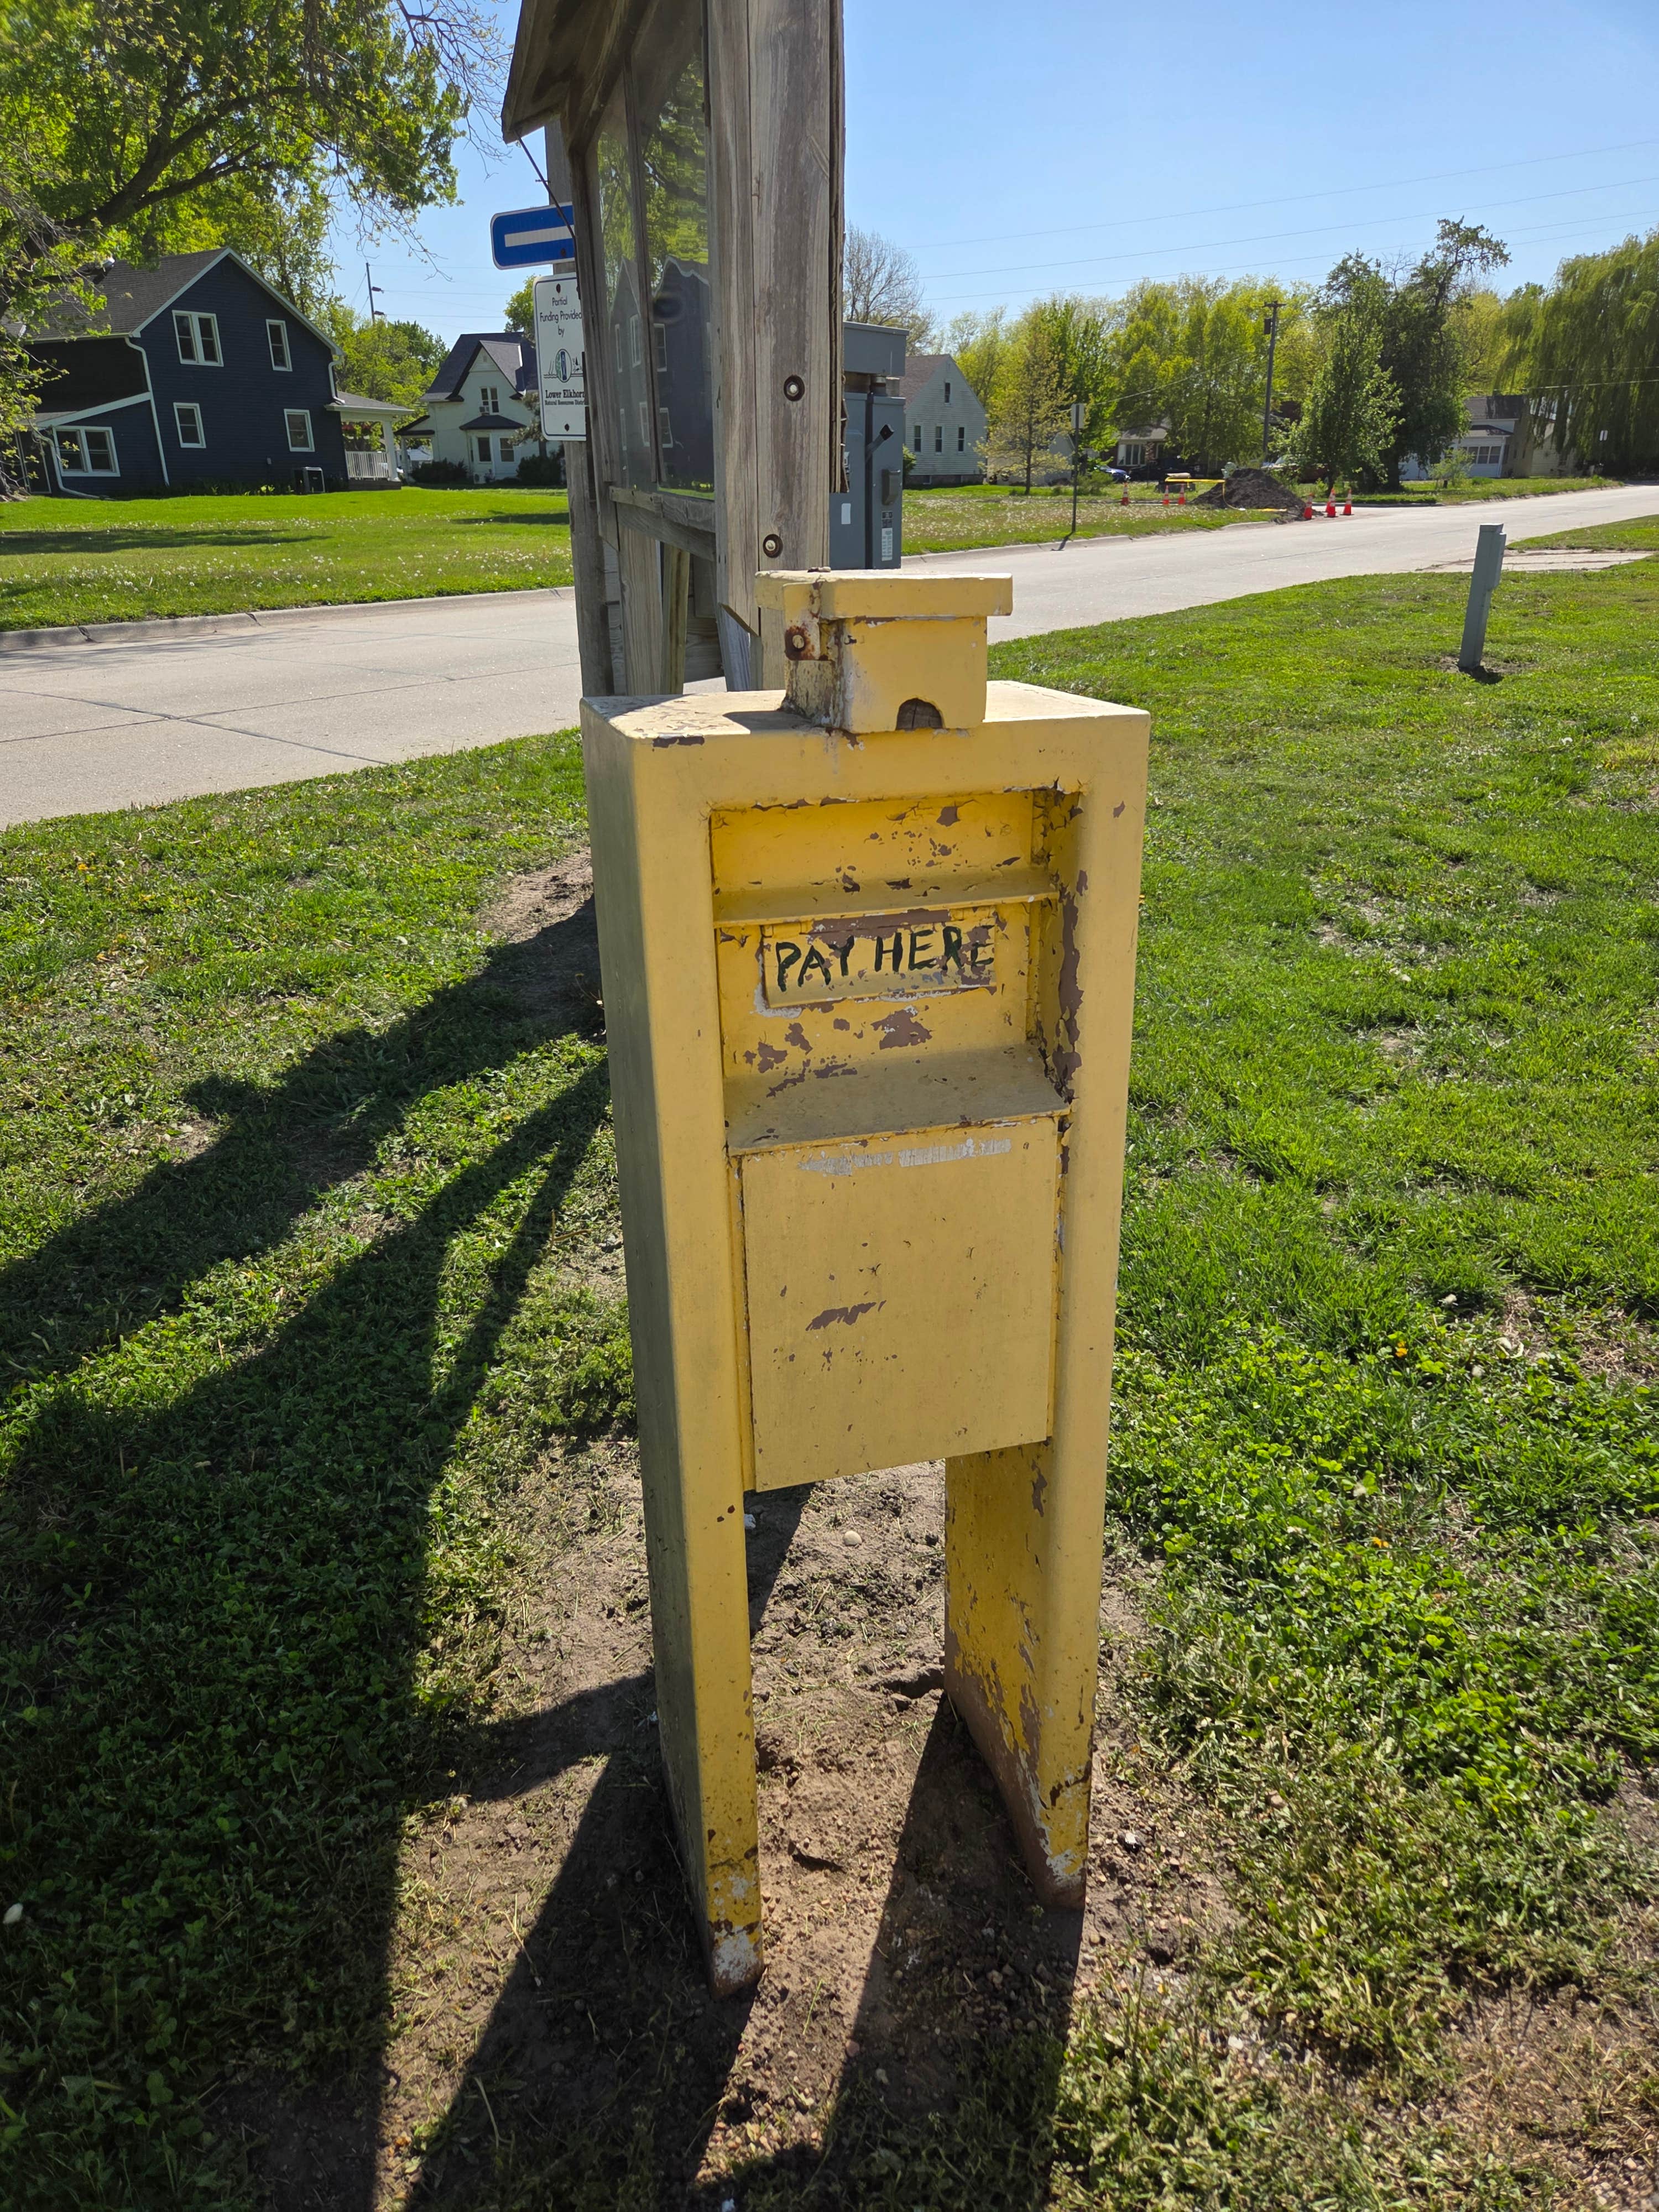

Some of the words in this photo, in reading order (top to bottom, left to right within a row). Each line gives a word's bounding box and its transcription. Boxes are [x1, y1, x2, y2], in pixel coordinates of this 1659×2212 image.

[552, 295, 567, 306] Partial
[540, 311, 559, 324] Funding
[558, 325, 565, 338] by
[545, 390, 561, 398] Lower
[776, 935, 854, 993] PAY
[875, 925, 995, 975] HERE
